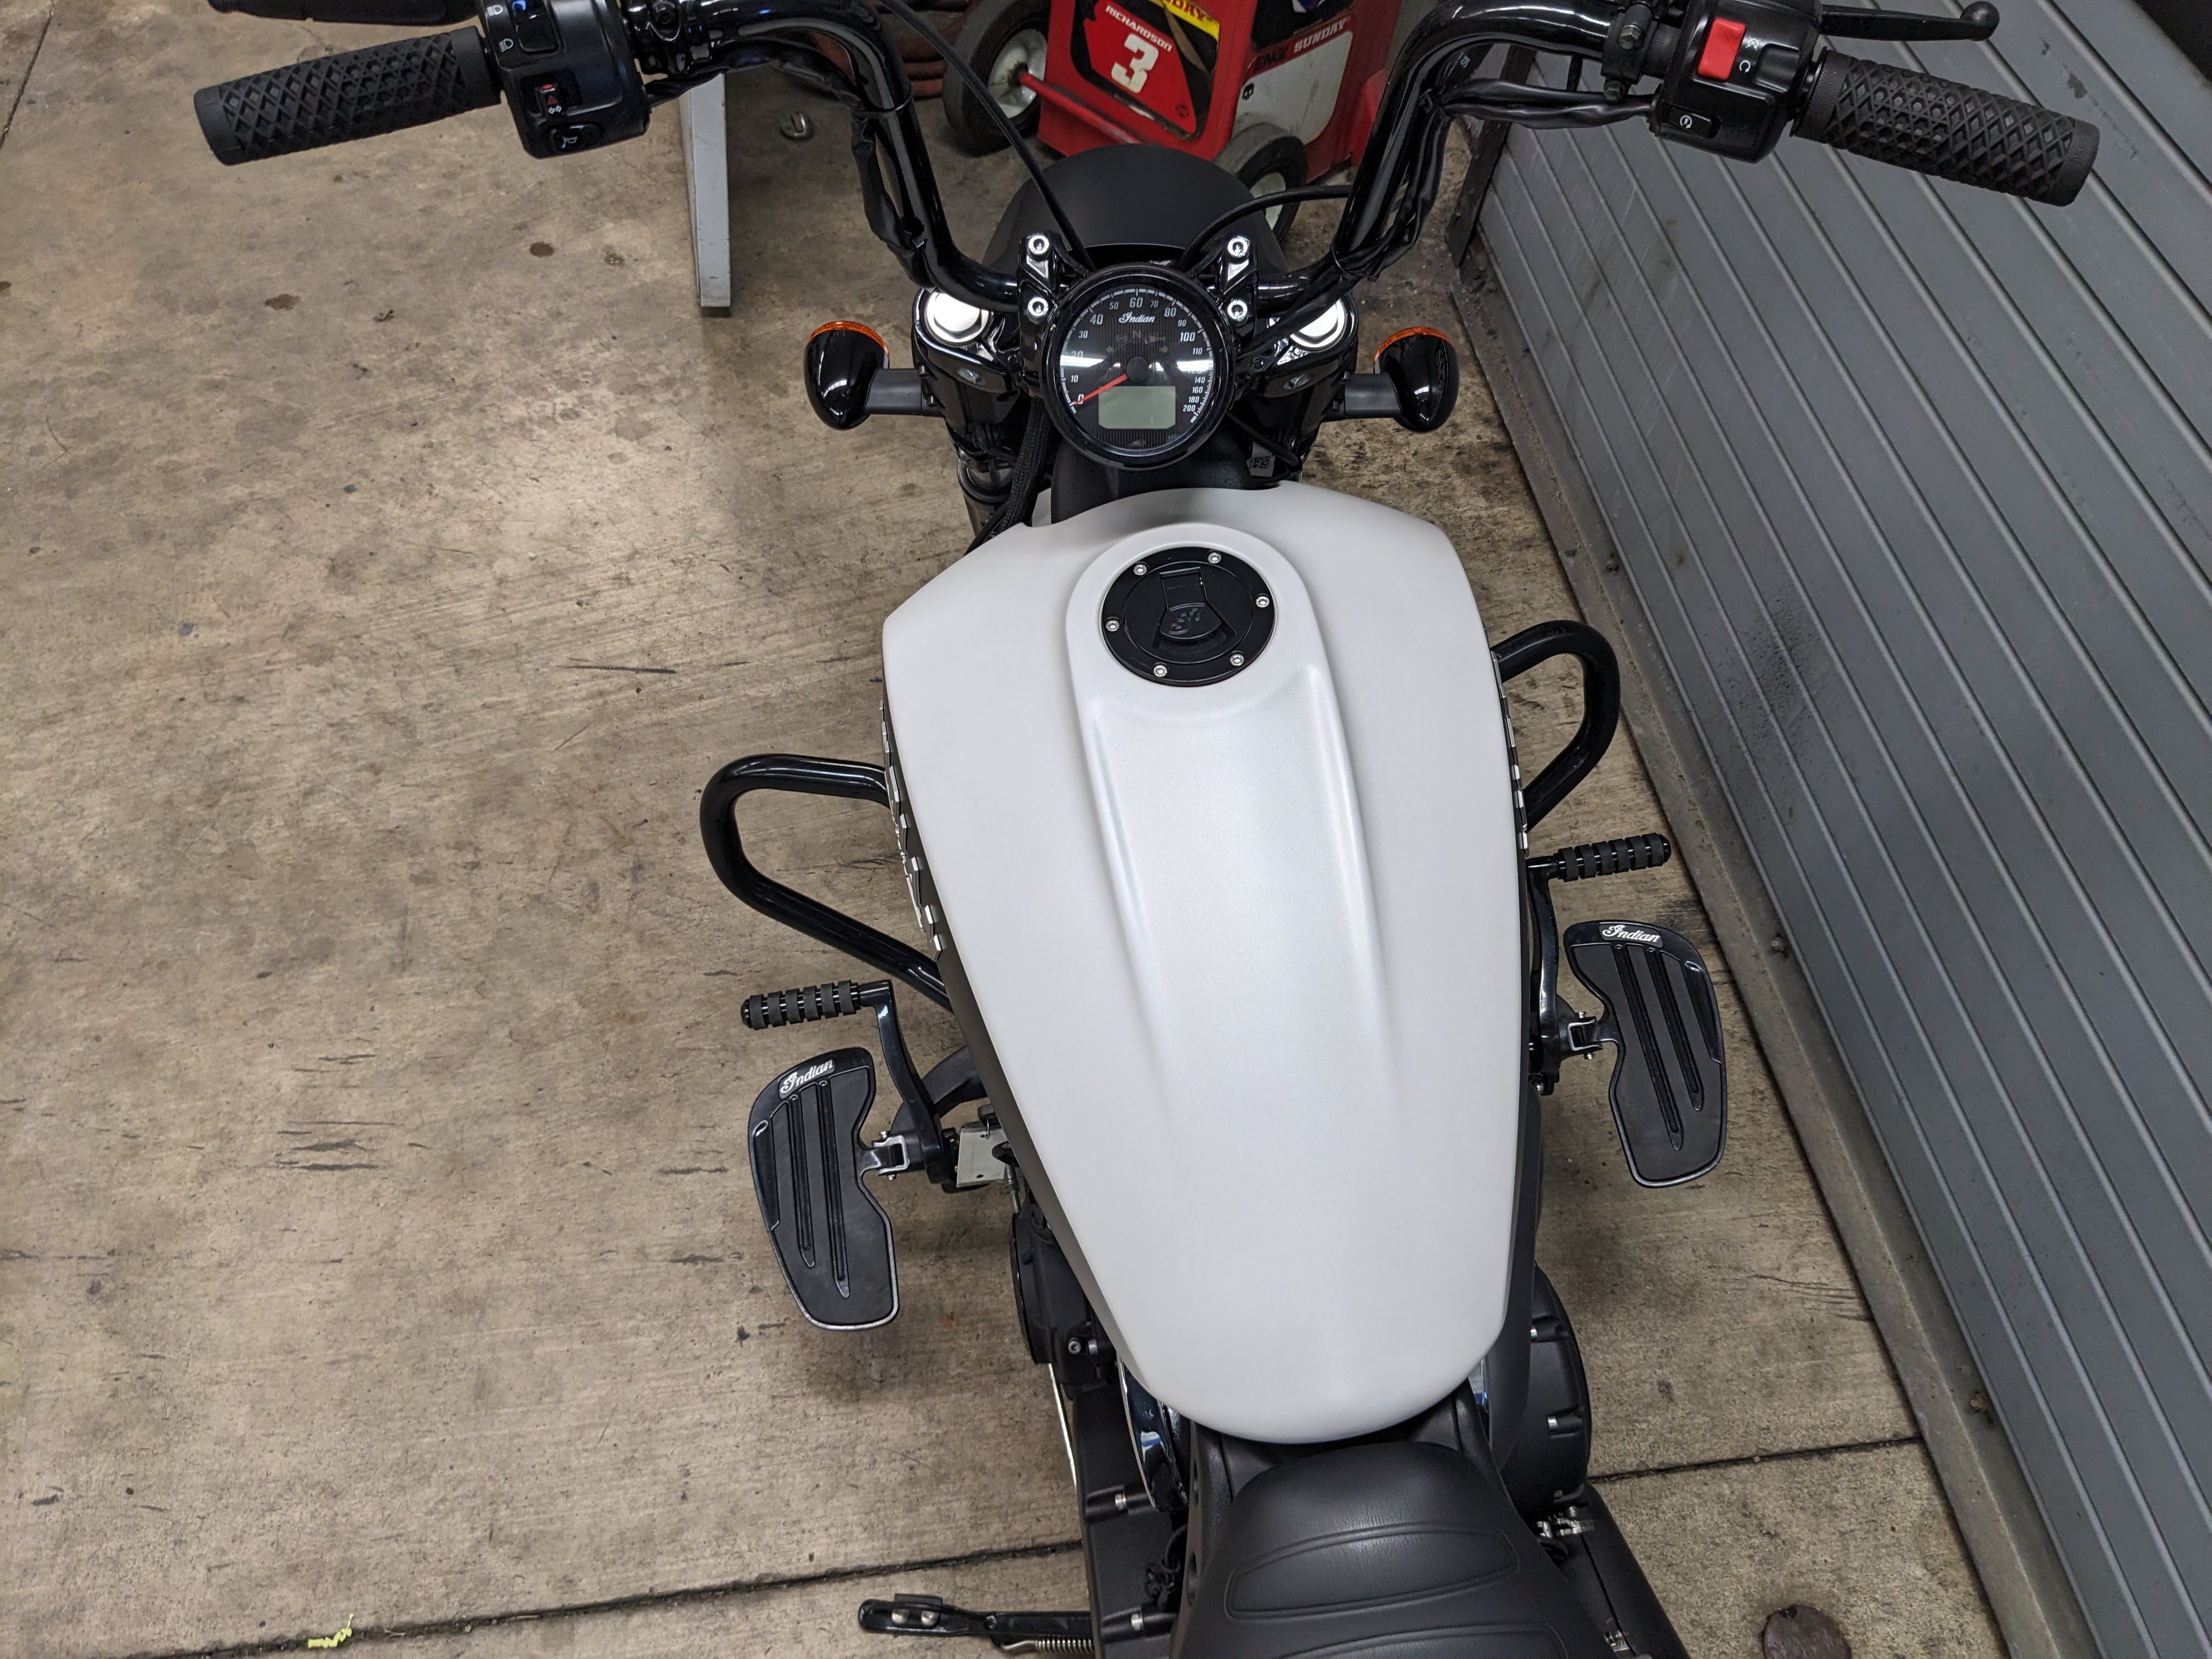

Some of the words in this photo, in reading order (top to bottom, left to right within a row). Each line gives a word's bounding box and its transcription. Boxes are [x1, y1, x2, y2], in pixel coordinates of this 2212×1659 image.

[1111, 33, 1159, 93] 3
[1109, 302, 1119, 310] 50
[1130, 297, 1143, 308] 60
[1119, 312, 1155, 323] Indian
[1164, 308, 1176, 317] 80
[1090, 314, 1103, 325] 40
[1180, 332, 1196, 342] 100
[1602, 924, 1660, 943] Indian
[780, 1059, 833, 1094] Indian
